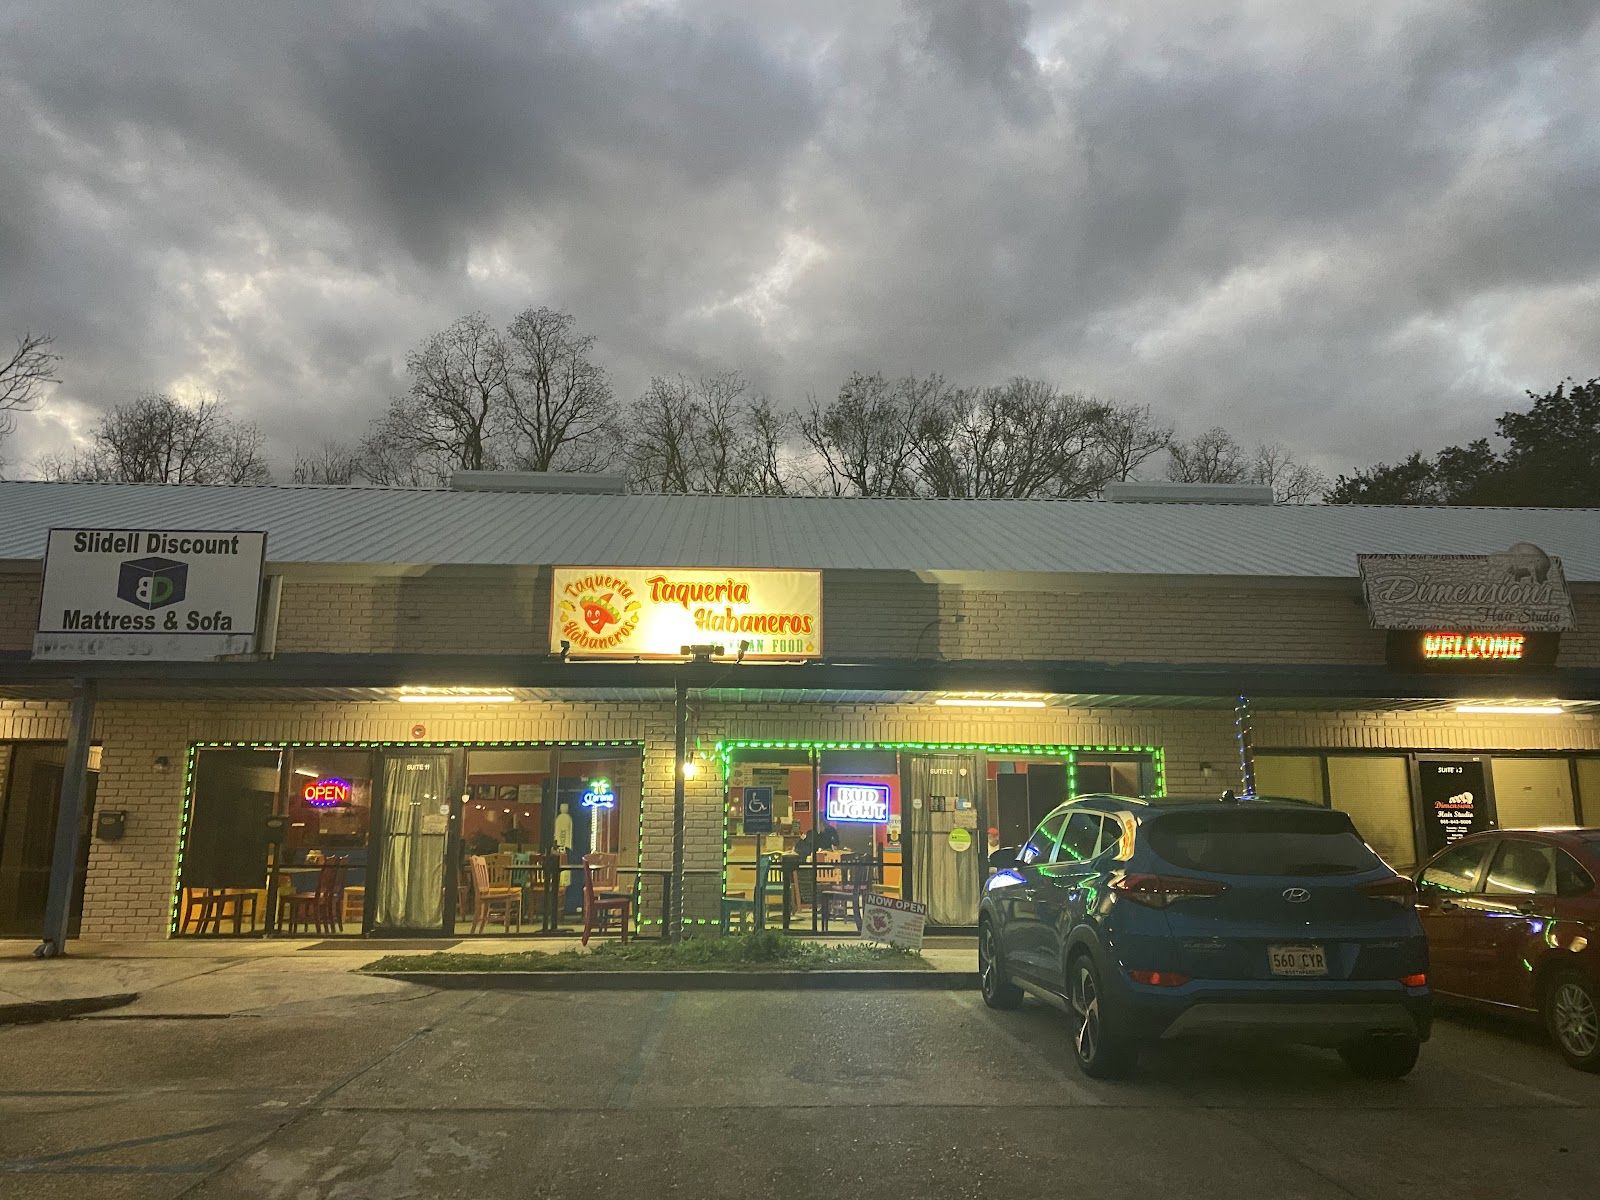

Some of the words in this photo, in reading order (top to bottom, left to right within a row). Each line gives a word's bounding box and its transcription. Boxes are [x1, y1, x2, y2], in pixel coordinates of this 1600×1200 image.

[73, 532, 139, 553] Slidell
[146, 533, 239, 554] Discount
[564, 575, 634, 599] Taqueria
[647, 577, 749, 609] Taqueria
[1375, 575, 1552, 603] Dimensions
[62, 609, 155, 630] Mattress
[163, 611, 178, 631] &
[186, 611, 232, 631] Sofa
[694, 607, 812, 633] Habaneros
[1476, 607, 1516, 623] Hair
[1519, 608, 1560, 623] Studio
[563, 621, 635, 648] Habaneros
[772, 639, 803, 653] FOOD
[1424, 634, 1525, 659] WELCOME
[304, 785, 346, 800] OPEN
[838, 788, 879, 803] BUD
[830, 801, 885, 819] LIGHT
[867, 894, 893, 908] NOW
[895, 900, 925, 914] OPEN
[1273, 954, 1295, 968] 560
[1302, 954, 1324, 968] CYR
